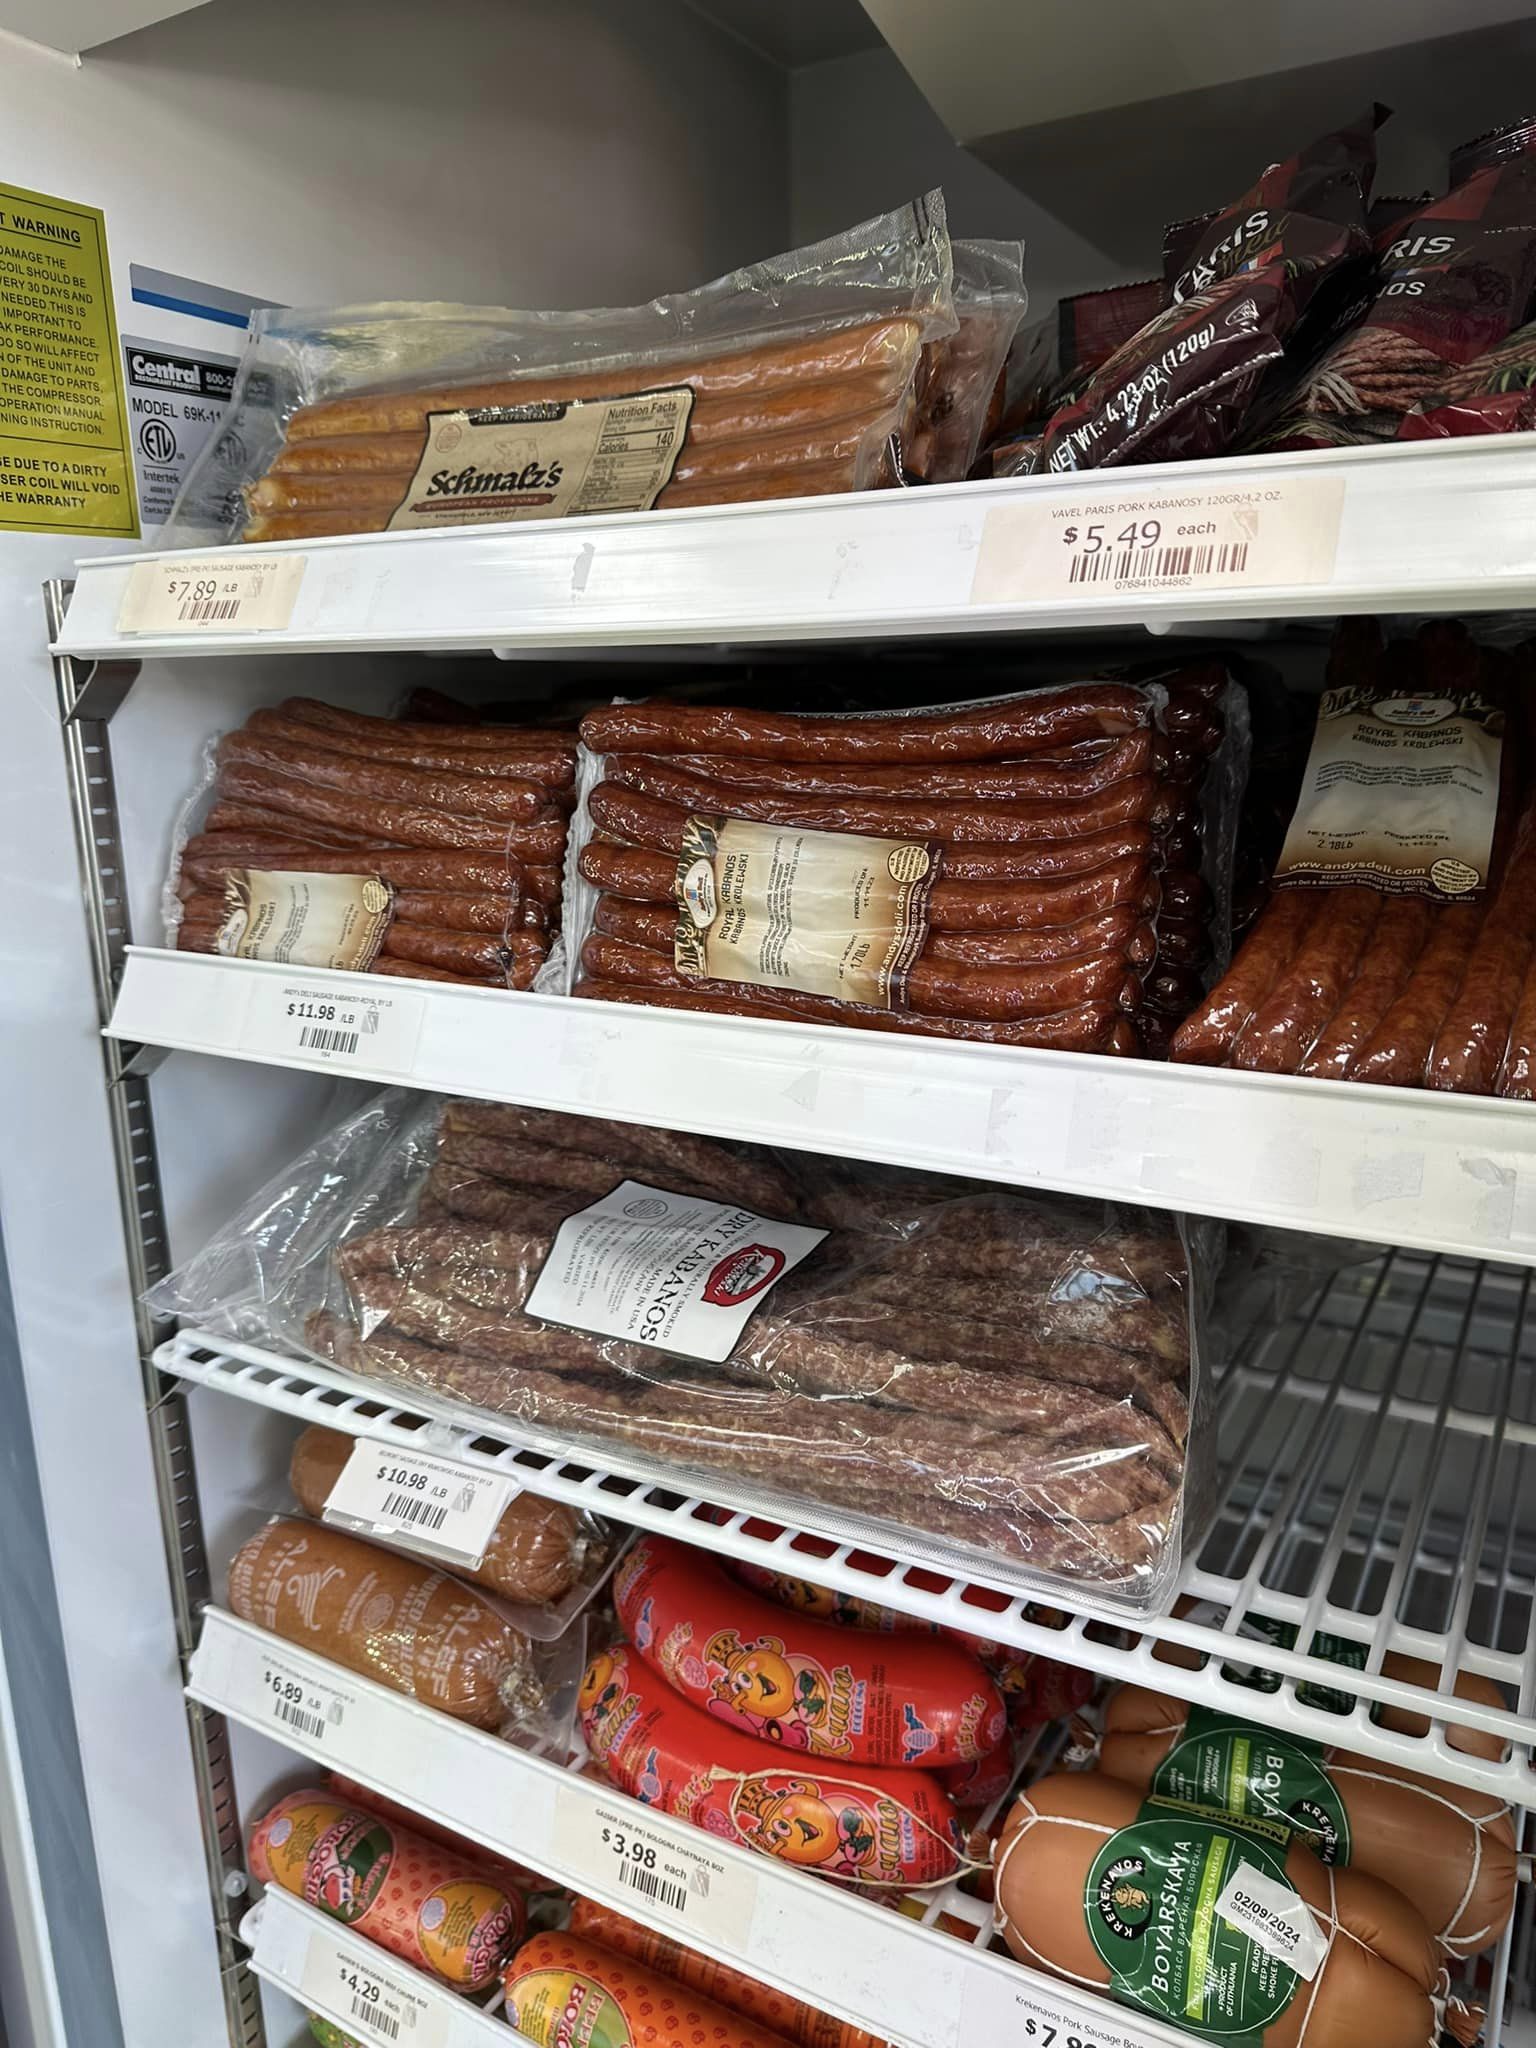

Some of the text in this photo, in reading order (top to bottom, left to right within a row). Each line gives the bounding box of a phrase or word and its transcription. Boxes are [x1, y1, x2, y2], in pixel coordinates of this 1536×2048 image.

[12, 215, 82, 242] WARNING
[0, 261, 88, 288] COIL SHOULD BE
[46, 255, 67, 269] THE
[28, 282, 93, 304] 30 DAYS AND
[3, 307, 82, 331] IMPORTANT TO
[49, 301, 74, 315] THIS
[76, 306, 87, 318] IS
[15, 324, 97, 348] PERFORMANCE
[16, 340, 100, 363] SO WILL AFFECT
[1161, 322, 1216, 376] (120g)
[1, 367, 49, 384] DAMAGE
[50, 376, 65, 386] TO
[7, 353, 96, 377] OF THE UNIT AND
[131, 354, 201, 385] Central
[2, 382, 25, 395] THE
[0, 398, 105, 421] OPERATION MANUAL
[132, 398, 179, 419] MODEL
[608, 400, 677, 419] Nutrition Facts
[600, 431, 674, 456] Calories 140
[1049, 438, 1079, 474] NET
[14, 457, 107, 478] DUE TO A DIRTY
[143, 469, 182, 485] Intertek
[426, 461, 565, 497] Schmalz's
[29, 476, 120, 495] COIL WILL VOID
[16, 493, 86, 509] WARRANTY
[1051, 508, 1083, 519] VAVEL
[1085, 506, 1115, 517] PARIS
[1117, 502, 1146, 513] PORK
[1148, 497, 1203, 511] KABANOSY
[1176, 520, 1217, 537] each
[1351, 734, 1465, 750] KABANOS KROLEWSKI
[1357, 723, 1463, 739] ROYAL KABANOS
[1288, 859, 1427, 877] www.andysdeli.com
[718, 854, 737, 940] ROYAL KABANOS
[731, 852, 749, 945] KABANOS KROLEWSKI
[877, 884, 908, 997] www.andysdeli.com
[716, 1212, 757, 1239] DRY
[626, 1268, 663, 1330] MADE IN USA
[639, 1239, 721, 1342] KABANOS
[662, 1300, 687, 1338] SMOKED
[264, 1538, 308, 1630] ALEF
[432, 1602, 481, 1698] ALEF
[646, 1831, 676, 1851] BOLOGNA
[664, 1862, 688, 1882] each
[1099, 1858, 1145, 1939] KREKENAVOS
[1151, 1840, 1193, 1994] BOYARSKAYA
[1173, 1842, 1204, 2001] КОЛБАСА ВАРЕНАЯ БОЯРСКАЯ
[1233, 1890, 1302, 1945] 02/09/2024
[1251, 1942, 1263, 1975] READY
[1217, 1966, 1230, 2005] PRODUCT
[1227, 1961, 1238, 2004] LITHUANIA
[1258, 1968, 1267, 1993] KEEP
[1267, 1965, 1279, 2000] SMOKE
[1015, 1993, 1122, 2047] Krekenavos Pork Sausage
